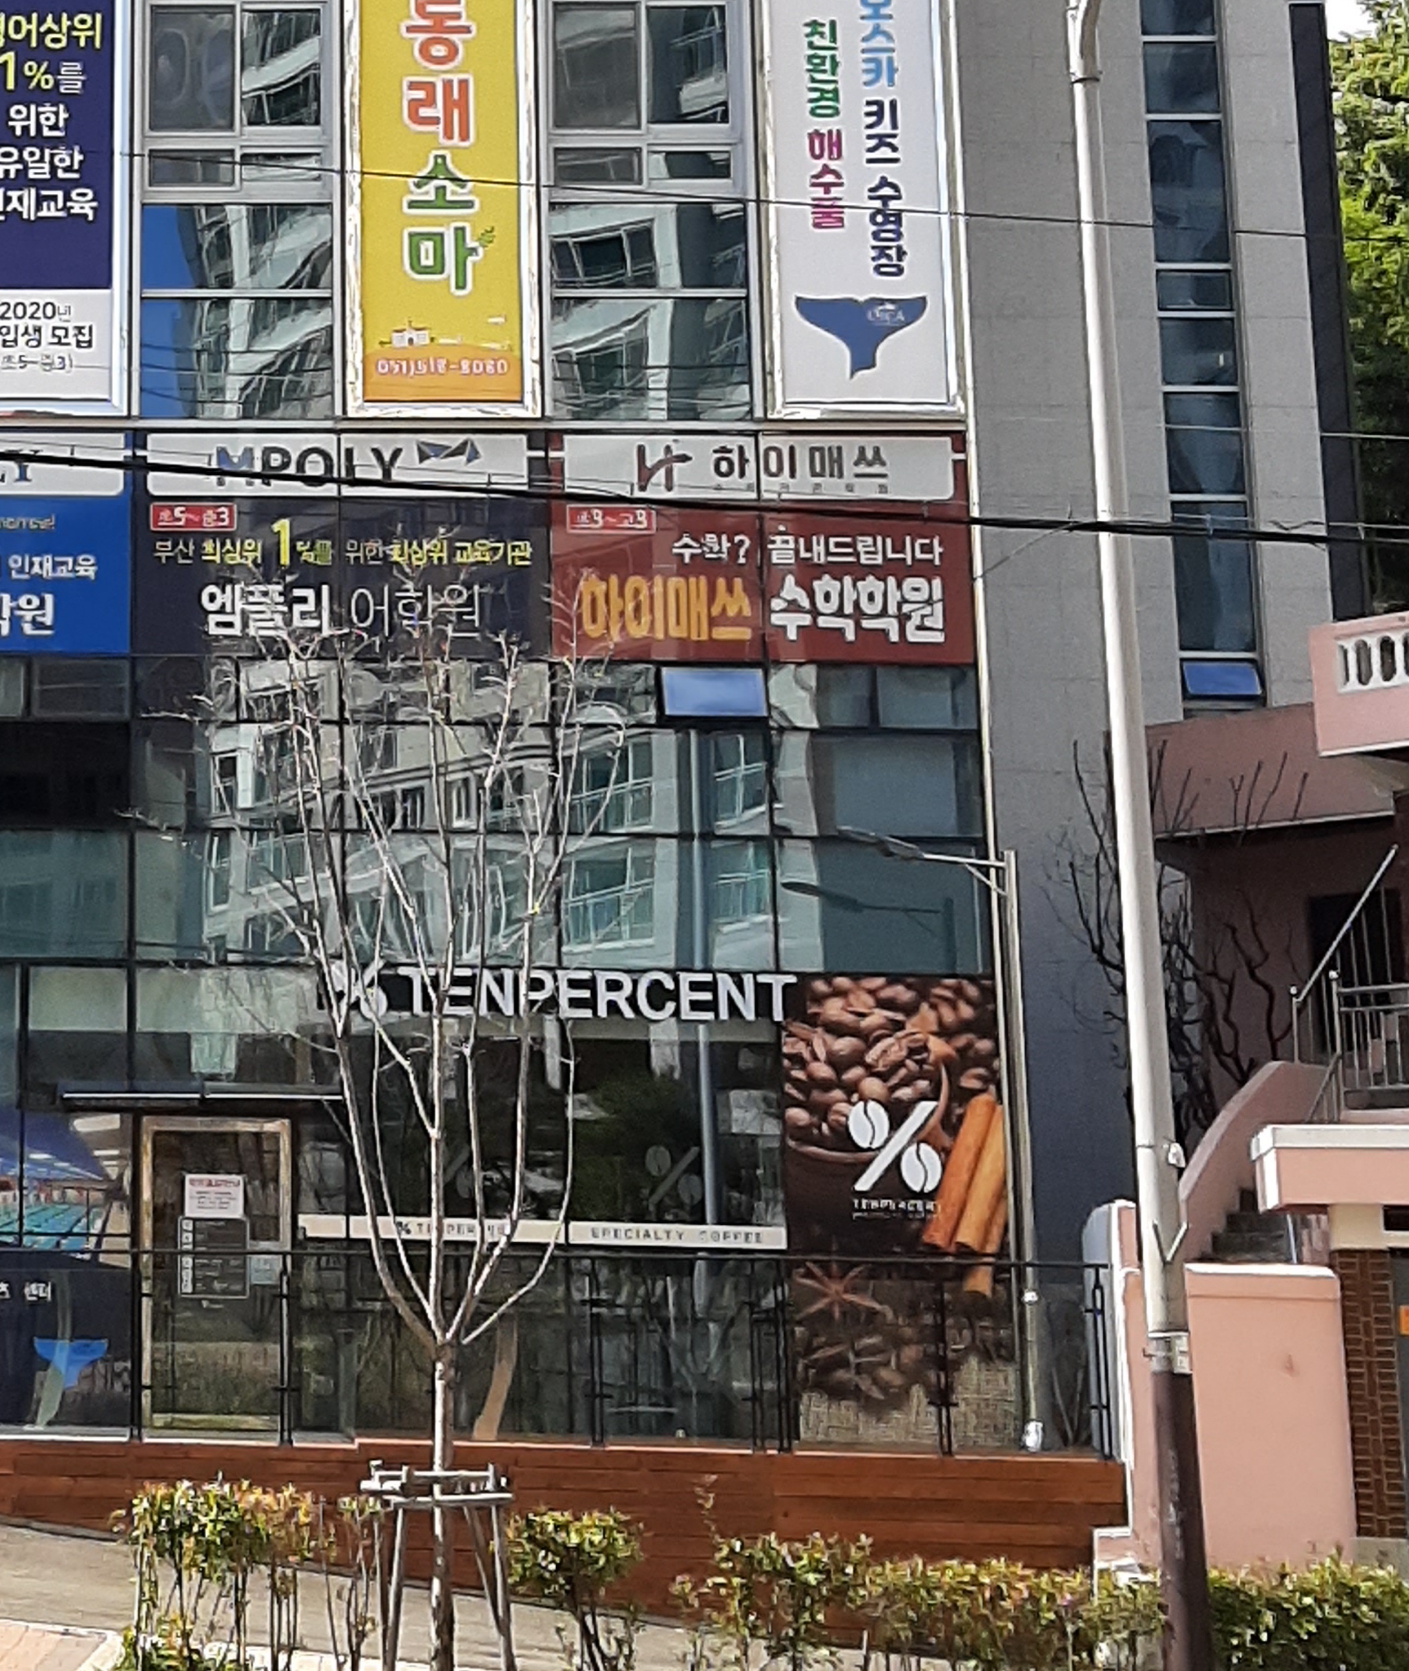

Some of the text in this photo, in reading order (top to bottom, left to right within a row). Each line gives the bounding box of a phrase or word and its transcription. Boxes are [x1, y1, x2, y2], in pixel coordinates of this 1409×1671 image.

[6, 103, 70, 138] 위한
[863, 97, 902, 165] 키즈
[401, 152, 481, 297] 소마
[867, 175, 906, 278] 수영장
[47, 323, 94, 349] 모집
[214, 445, 404, 488] MPOLY
[712, 444, 889, 480] 하이매쓰
[7, 553, 98, 580] 인재교육
[152, 538, 196, 566] 부산
[345, 538, 386, 565] 위한
[672, 527, 945, 567] 수학? 끝내드립니다
[580, 573, 946, 644] 하이매쓰 수학학원
[396, 966, 798, 1023] TENPERCENT
